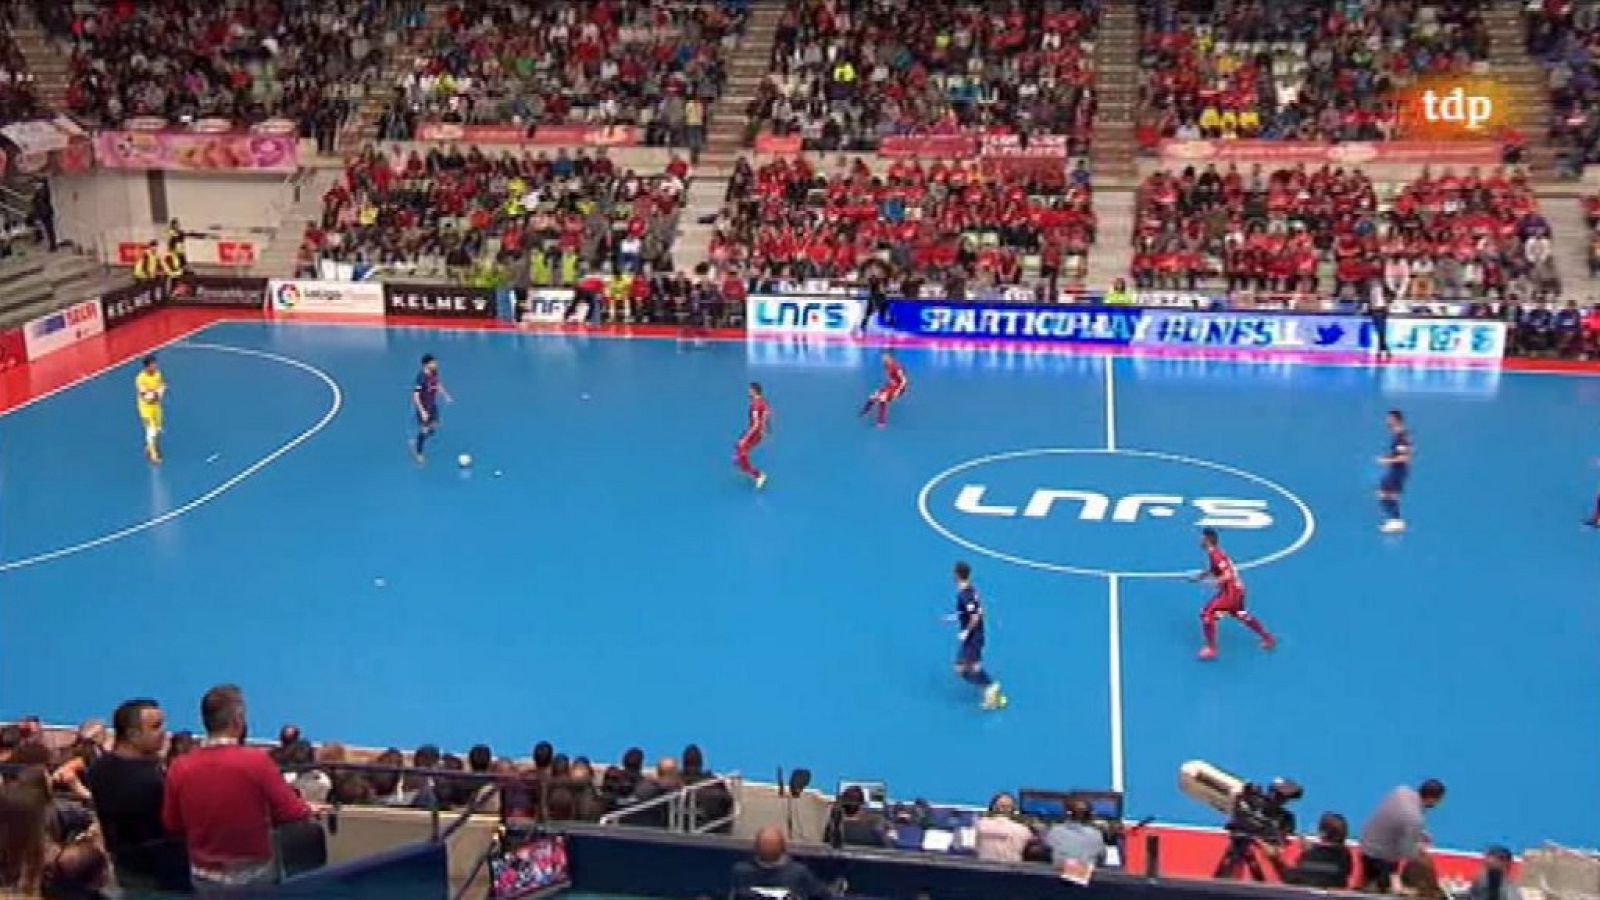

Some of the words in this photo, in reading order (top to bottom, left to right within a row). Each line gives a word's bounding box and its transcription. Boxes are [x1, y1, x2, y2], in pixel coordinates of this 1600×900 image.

[391, 294, 467, 310] KELME
[755, 303, 848, 329] LNFS
[954, 484, 1273, 528] LNFS
